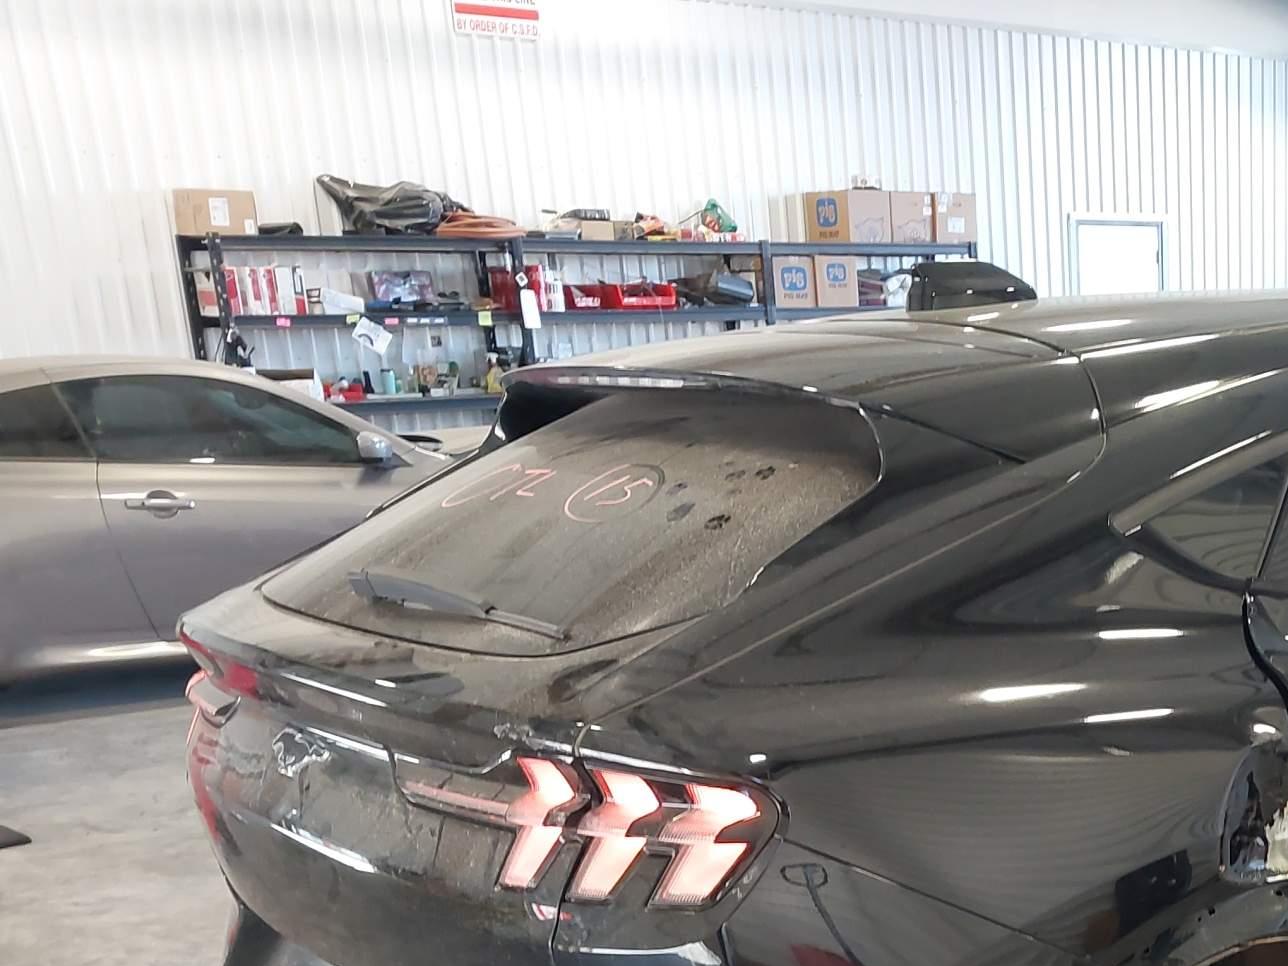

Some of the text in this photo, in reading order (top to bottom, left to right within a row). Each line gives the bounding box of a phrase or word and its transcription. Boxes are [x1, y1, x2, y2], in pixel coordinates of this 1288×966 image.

[457, 18, 466, 30] BY
[470, 19, 497, 32] ORDER
[499, 22, 510, 33] OF
